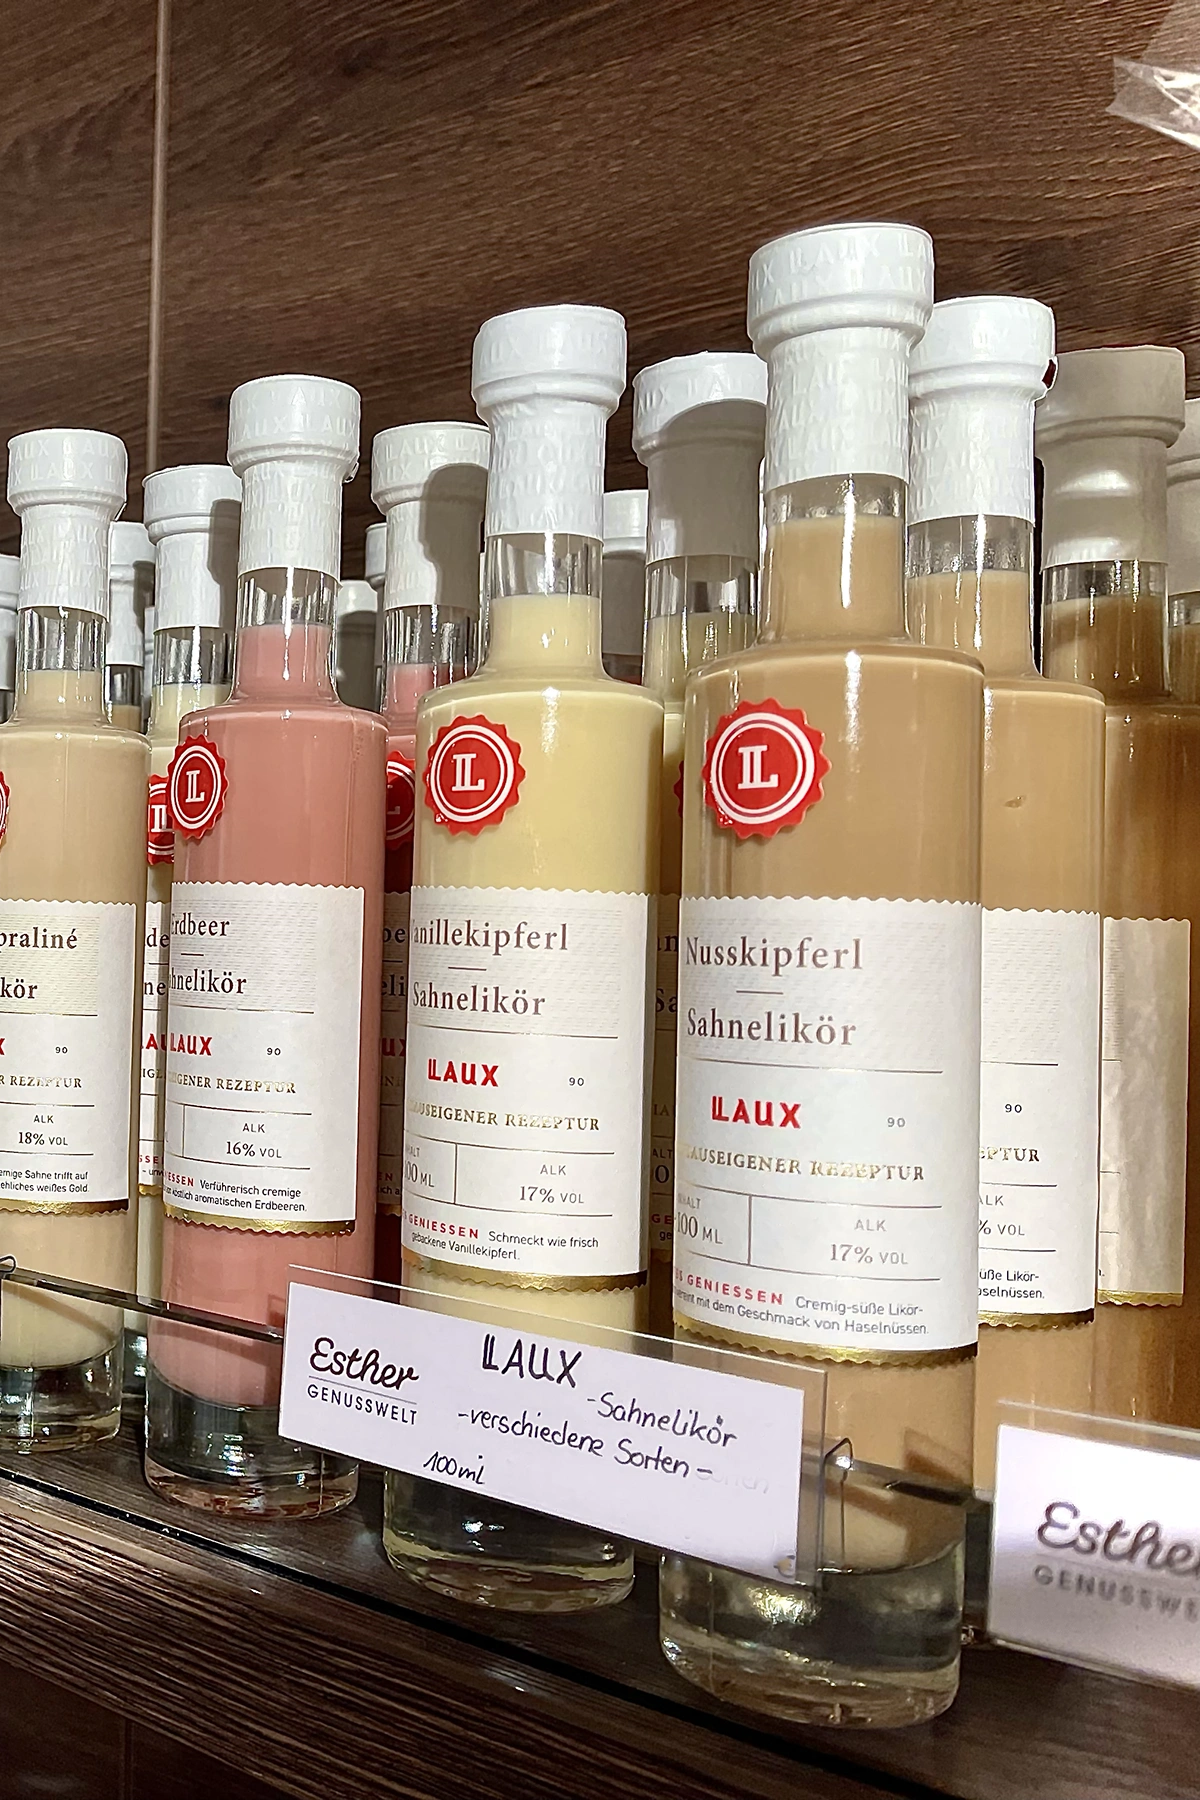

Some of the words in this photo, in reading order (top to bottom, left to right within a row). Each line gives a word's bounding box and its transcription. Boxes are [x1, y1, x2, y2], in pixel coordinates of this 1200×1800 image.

[411, 918, 568, 957] anillekipferl
[685, 936, 864, 977] Nusskipferl
[168, 967, 247, 995] hnelikör
[413, 981, 546, 1016] Sahnelikör
[687, 1007, 858, 1047] Sahnelikör
[55, 1046, 68, 1055] 90
[267, 1046, 281, 1056] 90
[428, 1058, 500, 1088] LAUX
[568, 1076, 586, 1088] 90
[216, 1077, 296, 1094] REZEPTUR
[711, 1095, 801, 1129] LAUX
[887, 1116, 906, 1129] 90
[1004, 1103, 1023, 1114] 90
[33, 1114, 54, 1124] ALK
[242, 1122, 266, 1134] ALK
[505, 1113, 600, 1131] REZEPTUR
[18, 1131, 45, 1146] 18%
[48, 1136, 68, 1146] VOL
[225, 1141, 256, 1157] 16%
[259, 1147, 282, 1159] VOL
[539, 1164, 567, 1176] ALK
[686, 1147, 802, 1175] AUSEIGENER
[809, 1160, 925, 1182] REZEPTUR
[24, 1169, 52, 1180] Sahne
[54, 1170, 73, 1181] trifft
[74, 1171, 88, 1180] auf
[420, 1172, 435, 1188] ML
[36, 1184, 67, 1193] weißes
[200, 1179, 260, 1196] Verführerisch
[262, 1186, 302, 1199] cremige
[519, 1186, 555, 1204] 17%
[560, 1192, 585, 1204] VOL
[194, 1194, 253, 1209] aromatischen
[408, 1213, 479, 1239] GENIESSEN
[488, 1230, 544, 1247] Schmeckt
[547, 1237, 567, 1248] wie
[570, 1236, 599, 1248] frisch
[853, 1219, 887, 1232] ALK
[997, 1223, 1026, 1236] VOL
[702, 1226, 723, 1245] ML
[829, 1243, 873, 1264] 17%
[879, 1251, 909, 1265] VOL
[1006, 1269, 1040, 1282] Likör-
[687, 1273, 784, 1306] GENIESSEN
[795, 1296, 885, 1316] Cremig-süße
[888, 1302, 924, 1316] Likör-
[696, 1295, 710, 1309] mit
[712, 1298, 735, 1316] dem
[736, 1304, 811, 1328] Geschmack
[814, 1318, 841, 1332] von
[844, 1320, 930, 1336] Haselnüssen.
[309, 1336, 419, 1391] Esther
[306, 1383, 418, 1428] GENUSSWELT
